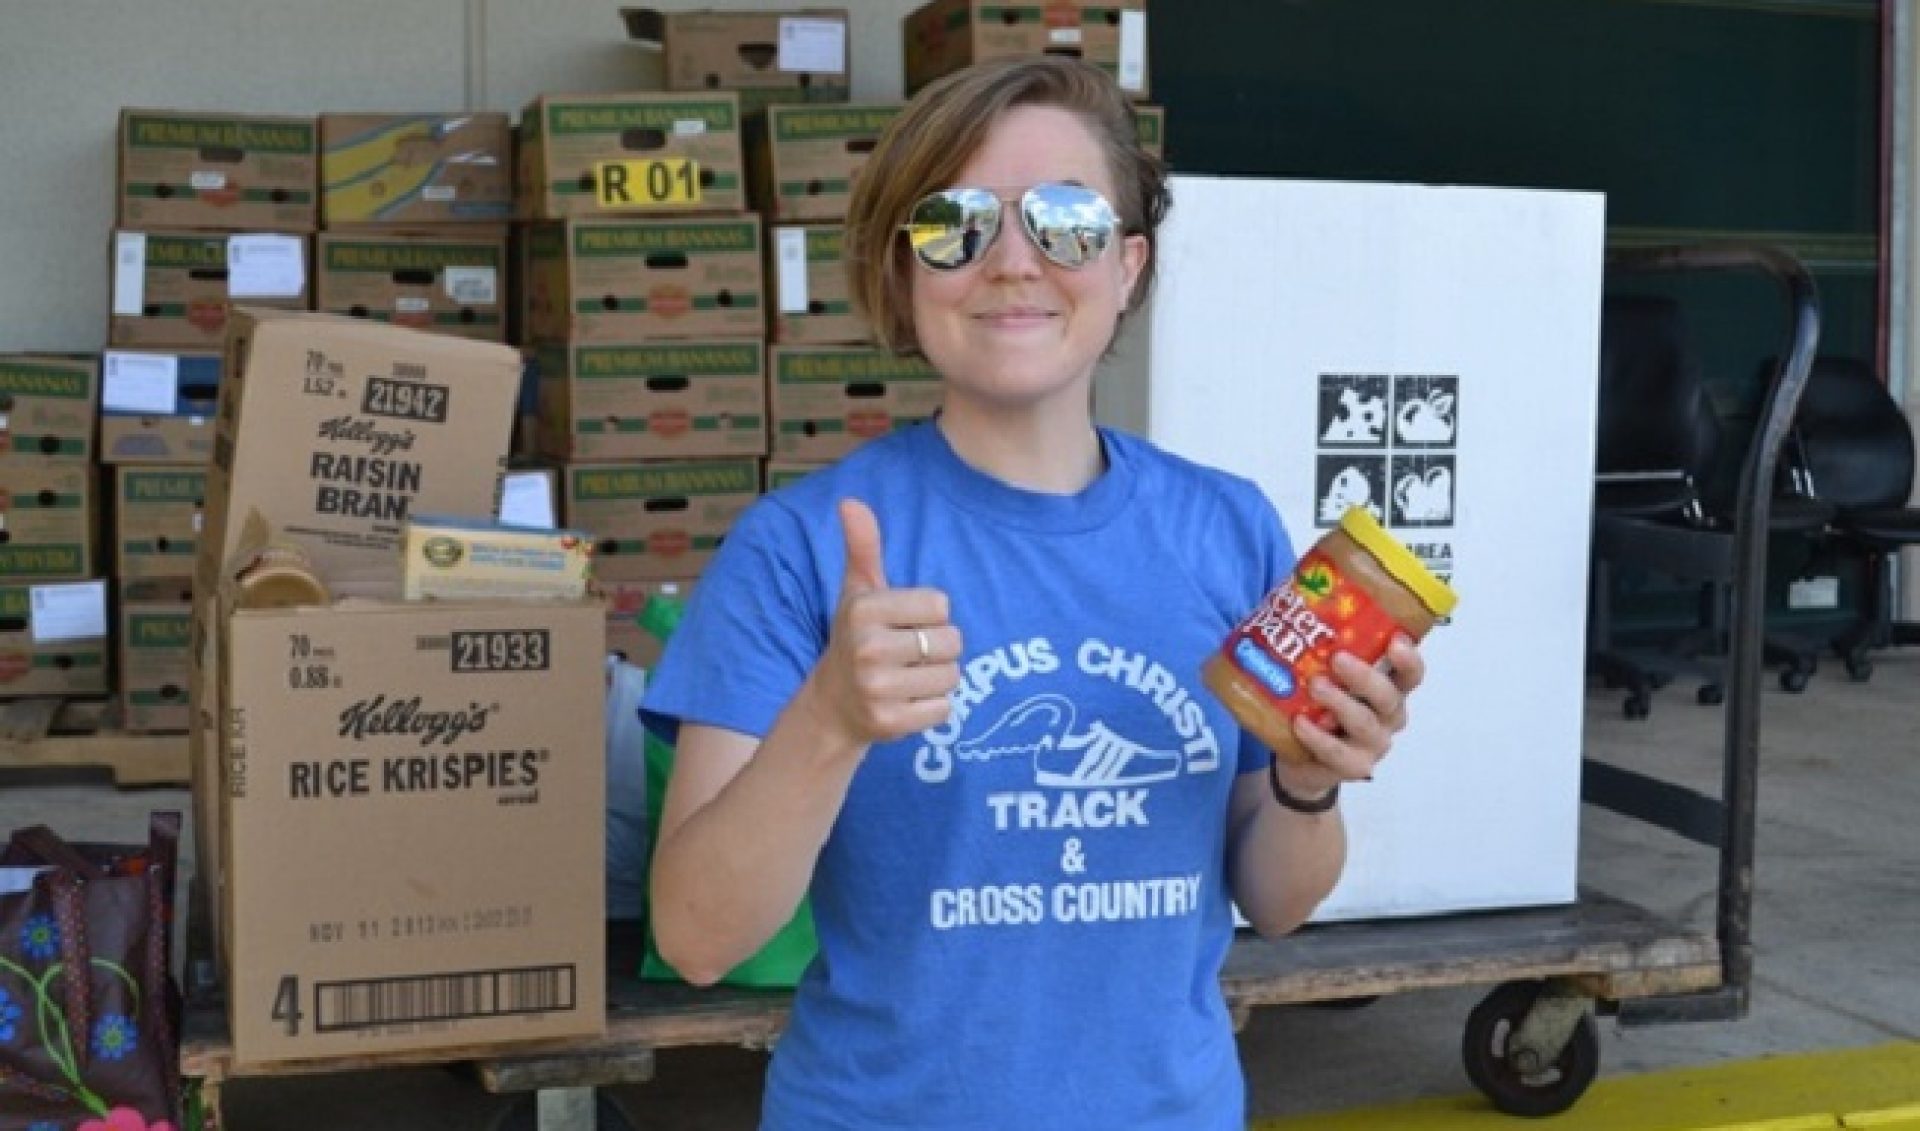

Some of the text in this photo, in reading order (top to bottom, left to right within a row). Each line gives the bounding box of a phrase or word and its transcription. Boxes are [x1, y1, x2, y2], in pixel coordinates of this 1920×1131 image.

[603, 161, 695, 204] R 01
[369, 382, 444, 419] 21942
[318, 416, 417, 456] Kellogg's
[310, 451, 423, 493] RAISIN
[316, 484, 410, 521] BRAN
[289, 634, 311, 660] 70
[455, 633, 546, 671] 21933
[338, 693, 489, 746] Kellogg's
[1076, 637, 1220, 773] CHRISTI
[289, 748, 540, 800] RICE KRISPIES
[986, 788, 1150, 831] TRACK
[1060, 836, 1086, 873] &
[930, 872, 1202, 930] CROSS COUNTRY
[272, 974, 304, 1037] 4
